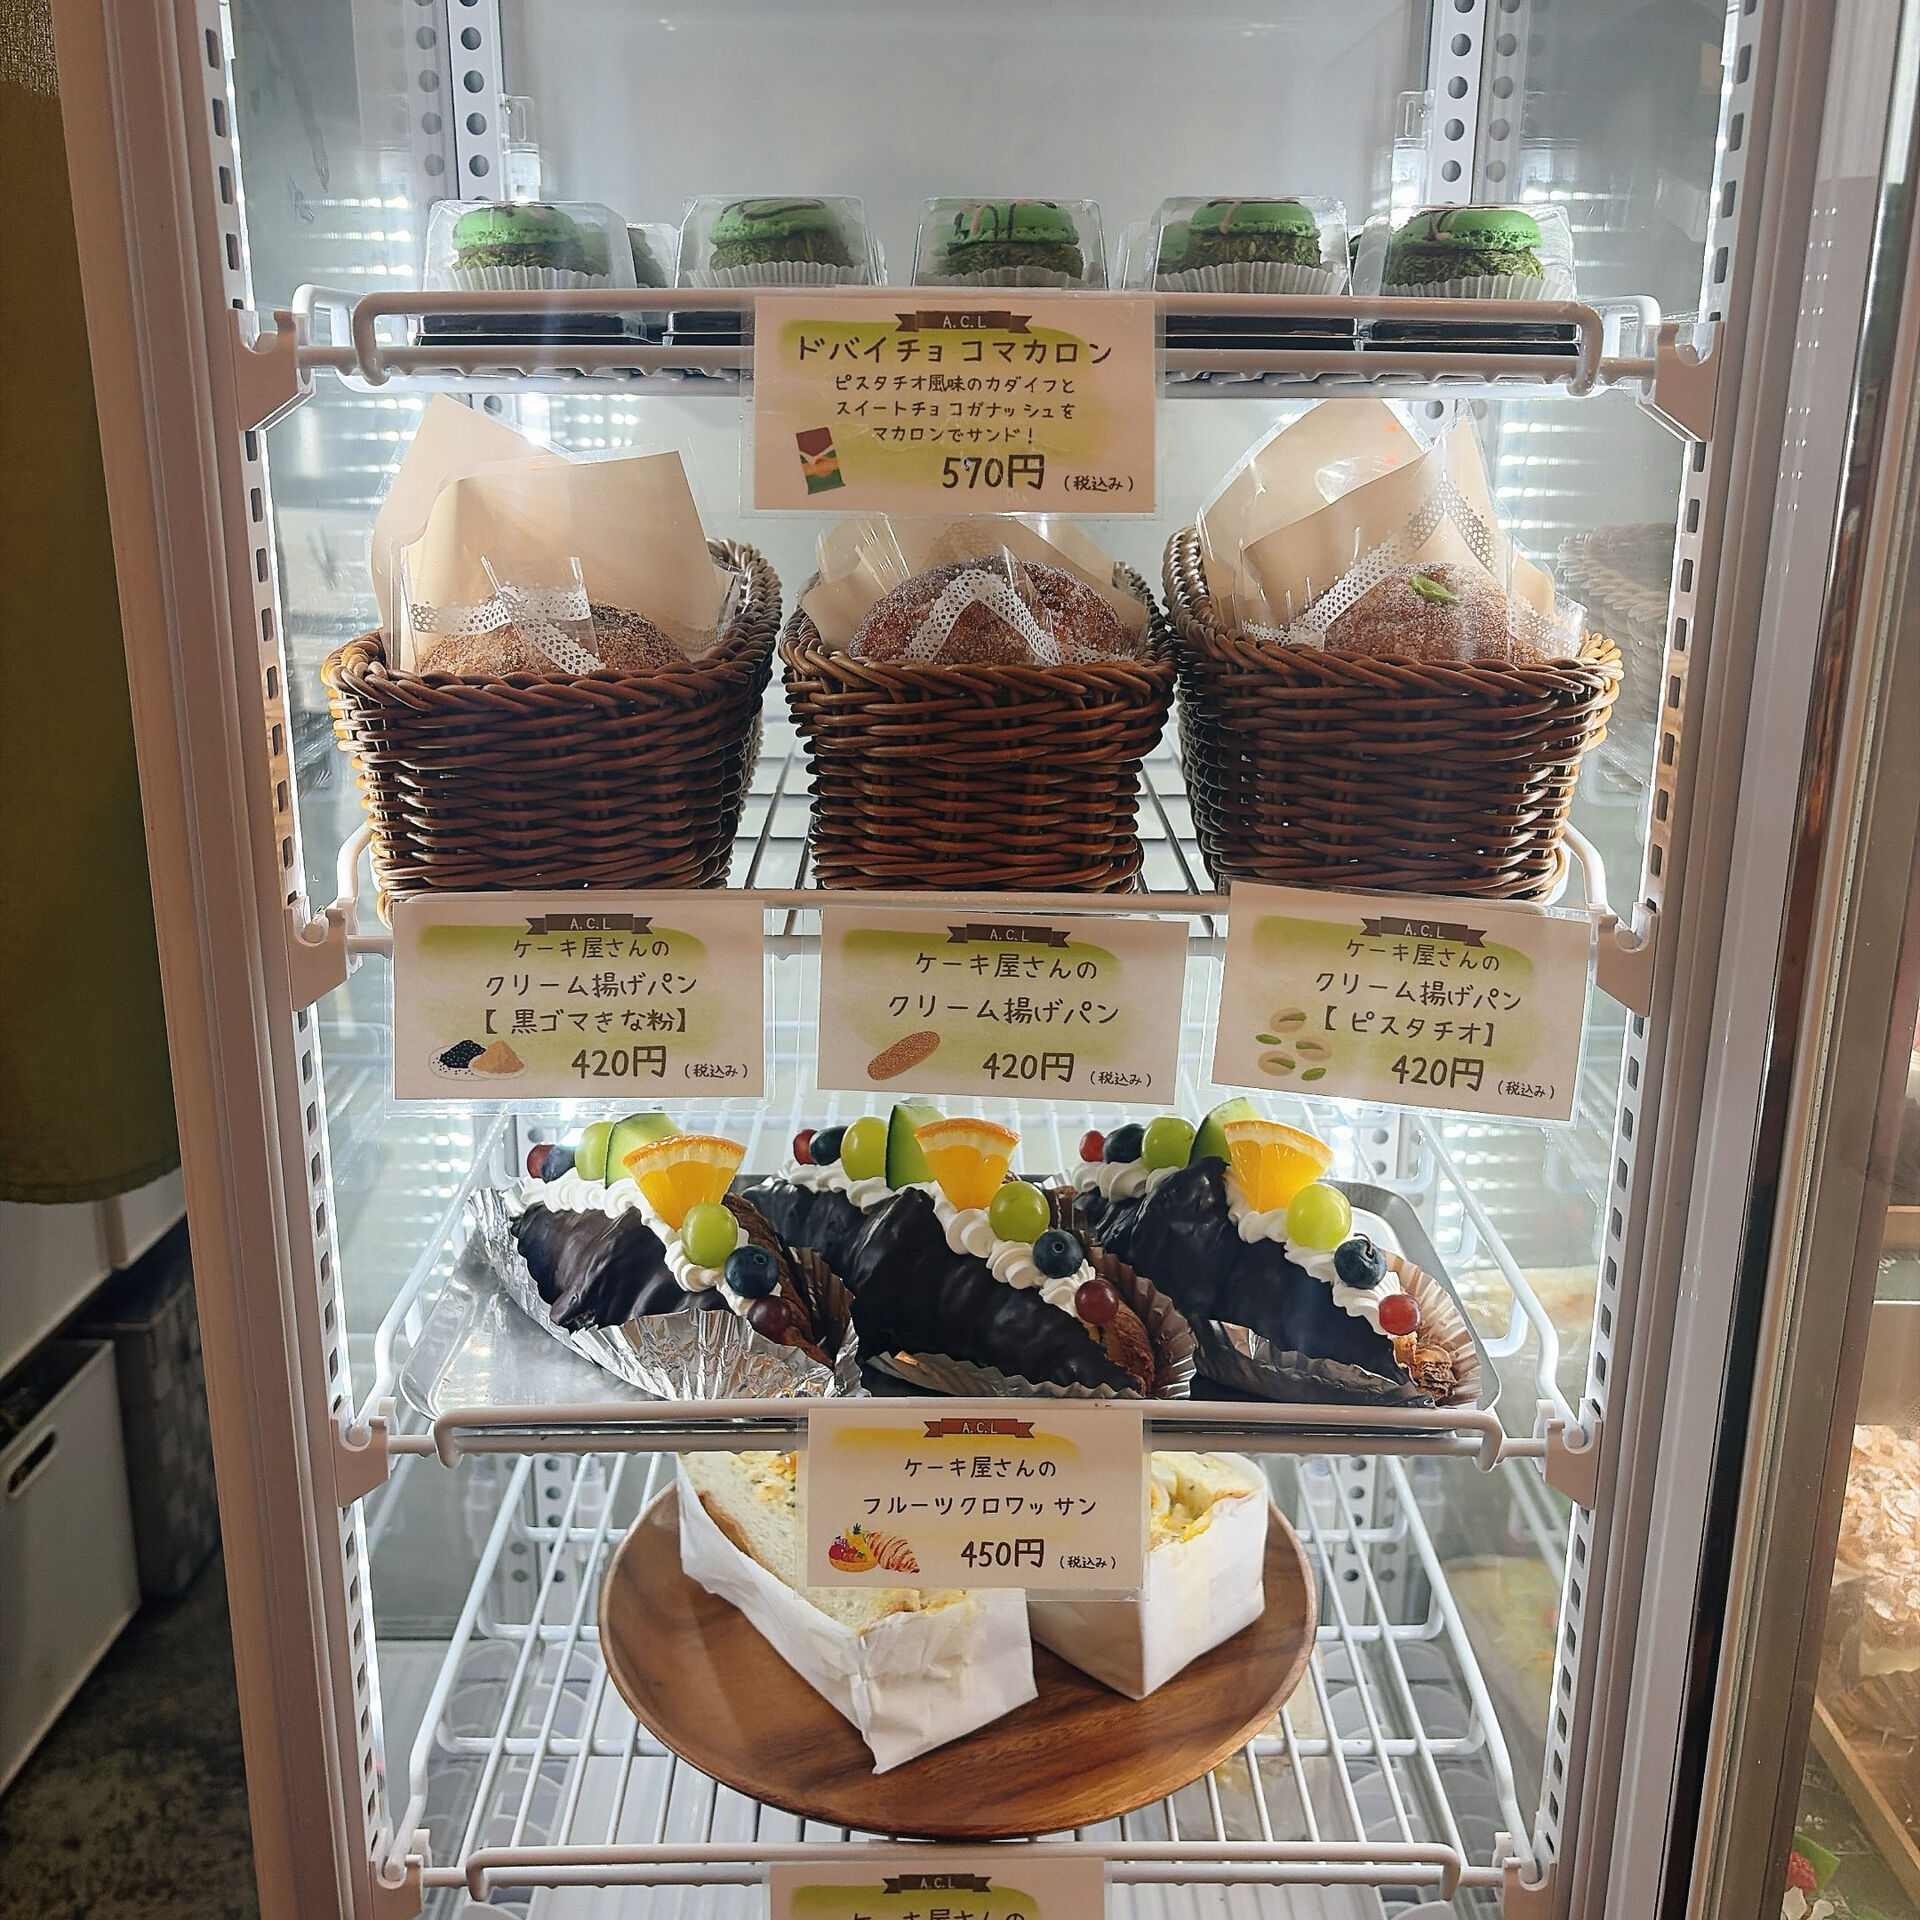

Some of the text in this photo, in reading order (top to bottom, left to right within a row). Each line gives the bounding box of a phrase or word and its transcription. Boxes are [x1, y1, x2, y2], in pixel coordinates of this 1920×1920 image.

[799, 334, 1112, 364] ドバイチョコマカロン
[836, 373, 1075, 394] ピスタチオ風味のカダイフと
[836, 399, 1076, 420] スイートチョコガナッシュを
[941, 453, 1045, 491] 570円
[513, 937, 670, 959] ケーキ屋さんの
[1346, 938, 1500, 972] ケーキ屋さんの
[915, 952, 1097, 980] ケーキ屋さんの
[485, 971, 697, 999] クリーム揚げパン
[1315, 972, 1522, 1012] クリーム揚げパン
[888, 994, 1119, 1025] クリーム揚げパン
[571, 1045, 667, 1080] 420円
[982, 1051, 1075, 1083] 420円
[1390, 1054, 1485, 1092] 420円
[904, 1456, 1057, 1479] ケーキ屋さんの
[863, 1496, 1097, 1517] フルーツクロワッサン
[960, 1538, 1045, 1569] 450円
